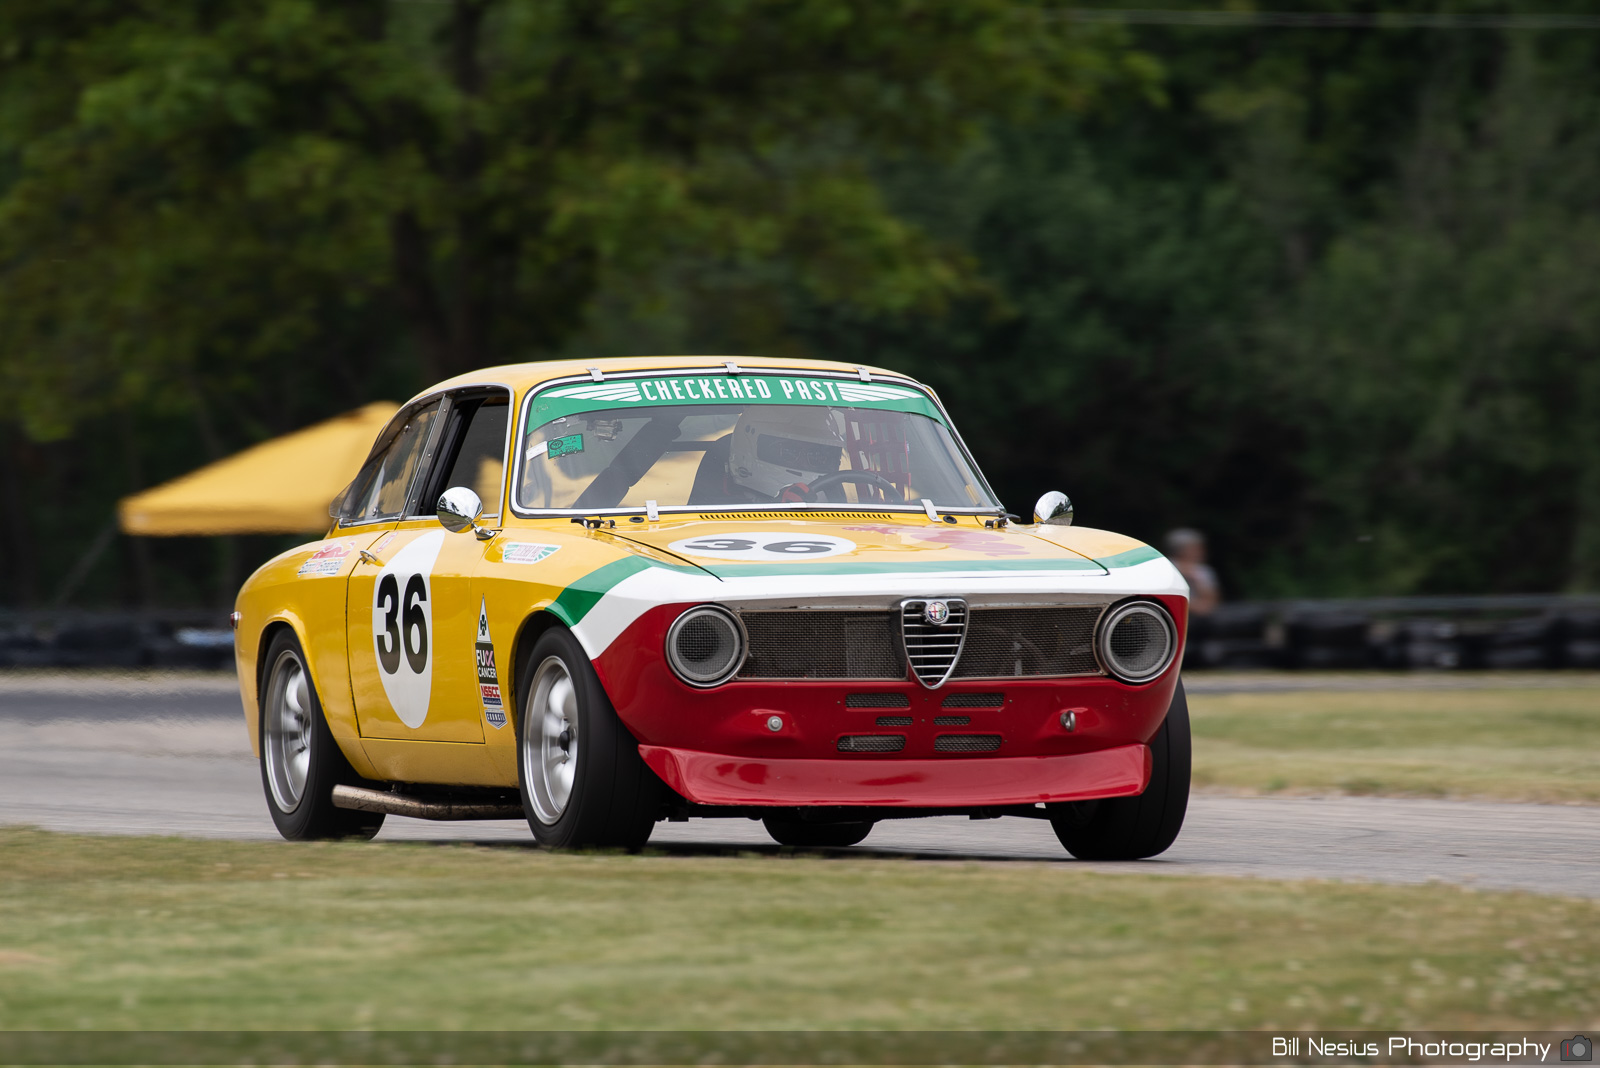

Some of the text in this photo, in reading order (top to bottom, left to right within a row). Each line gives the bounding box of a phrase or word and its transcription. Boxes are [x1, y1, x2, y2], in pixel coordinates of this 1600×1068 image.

[640, 378, 839, 401] CHECKERED PAST
[684, 538, 837, 554] 36
[376, 573, 428, 675] 36
[477, 667, 497, 678] CANCER
